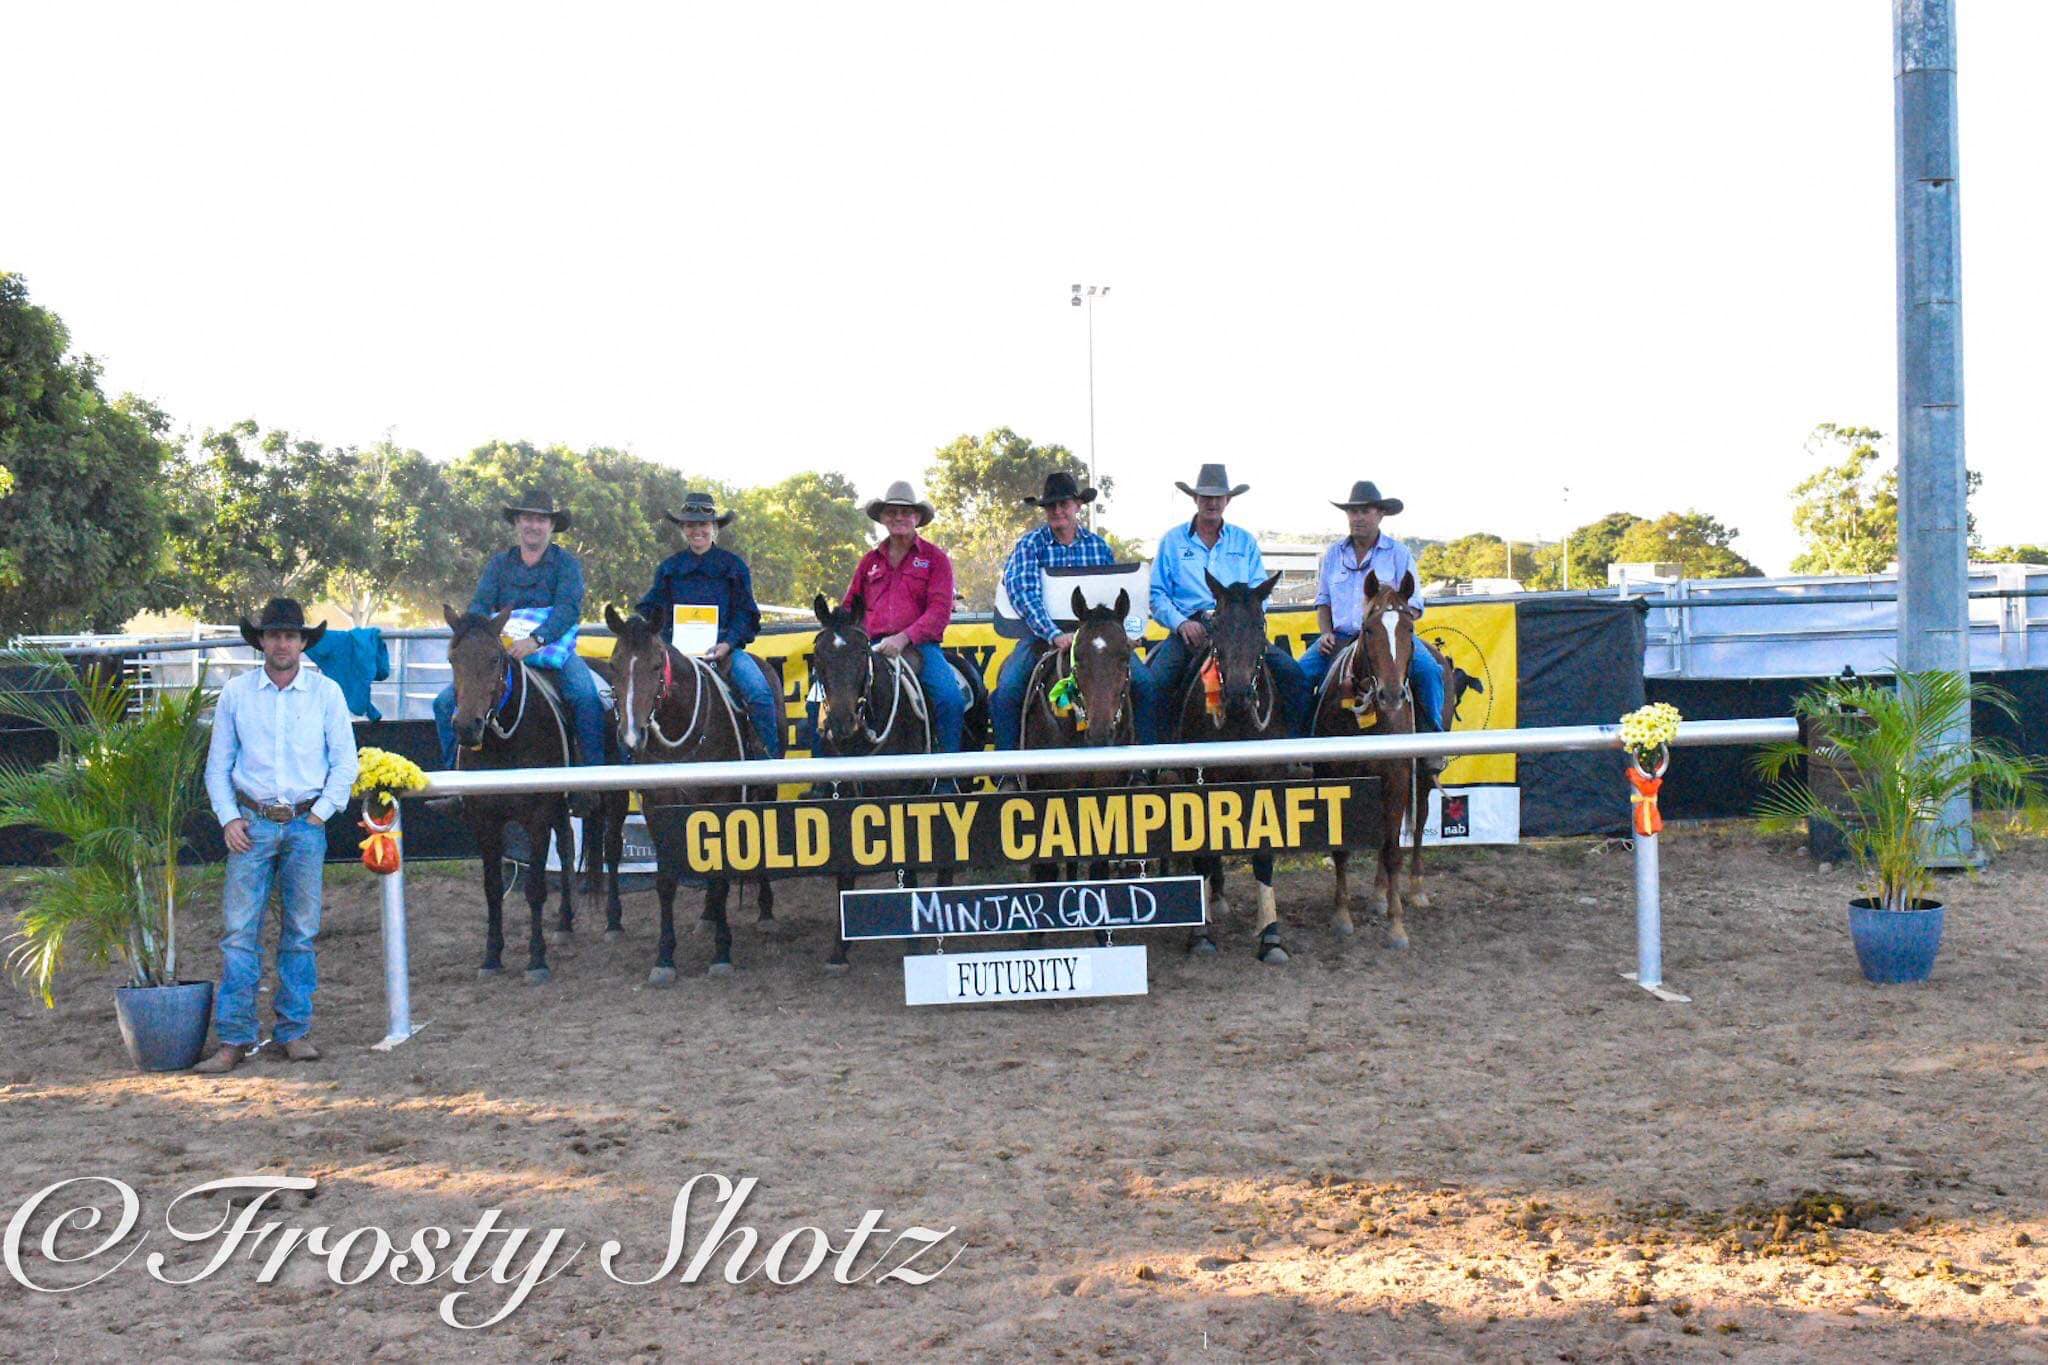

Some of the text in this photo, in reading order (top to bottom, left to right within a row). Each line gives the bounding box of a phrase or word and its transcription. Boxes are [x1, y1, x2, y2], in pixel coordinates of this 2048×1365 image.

[685, 785, 1351, 873] GOLD CITY CAMPDRAFT
[1444, 823, 1467, 836] nab
[911, 885, 1157, 932] MINJAR GOLD
[957, 956, 1079, 997] FUTURITY
